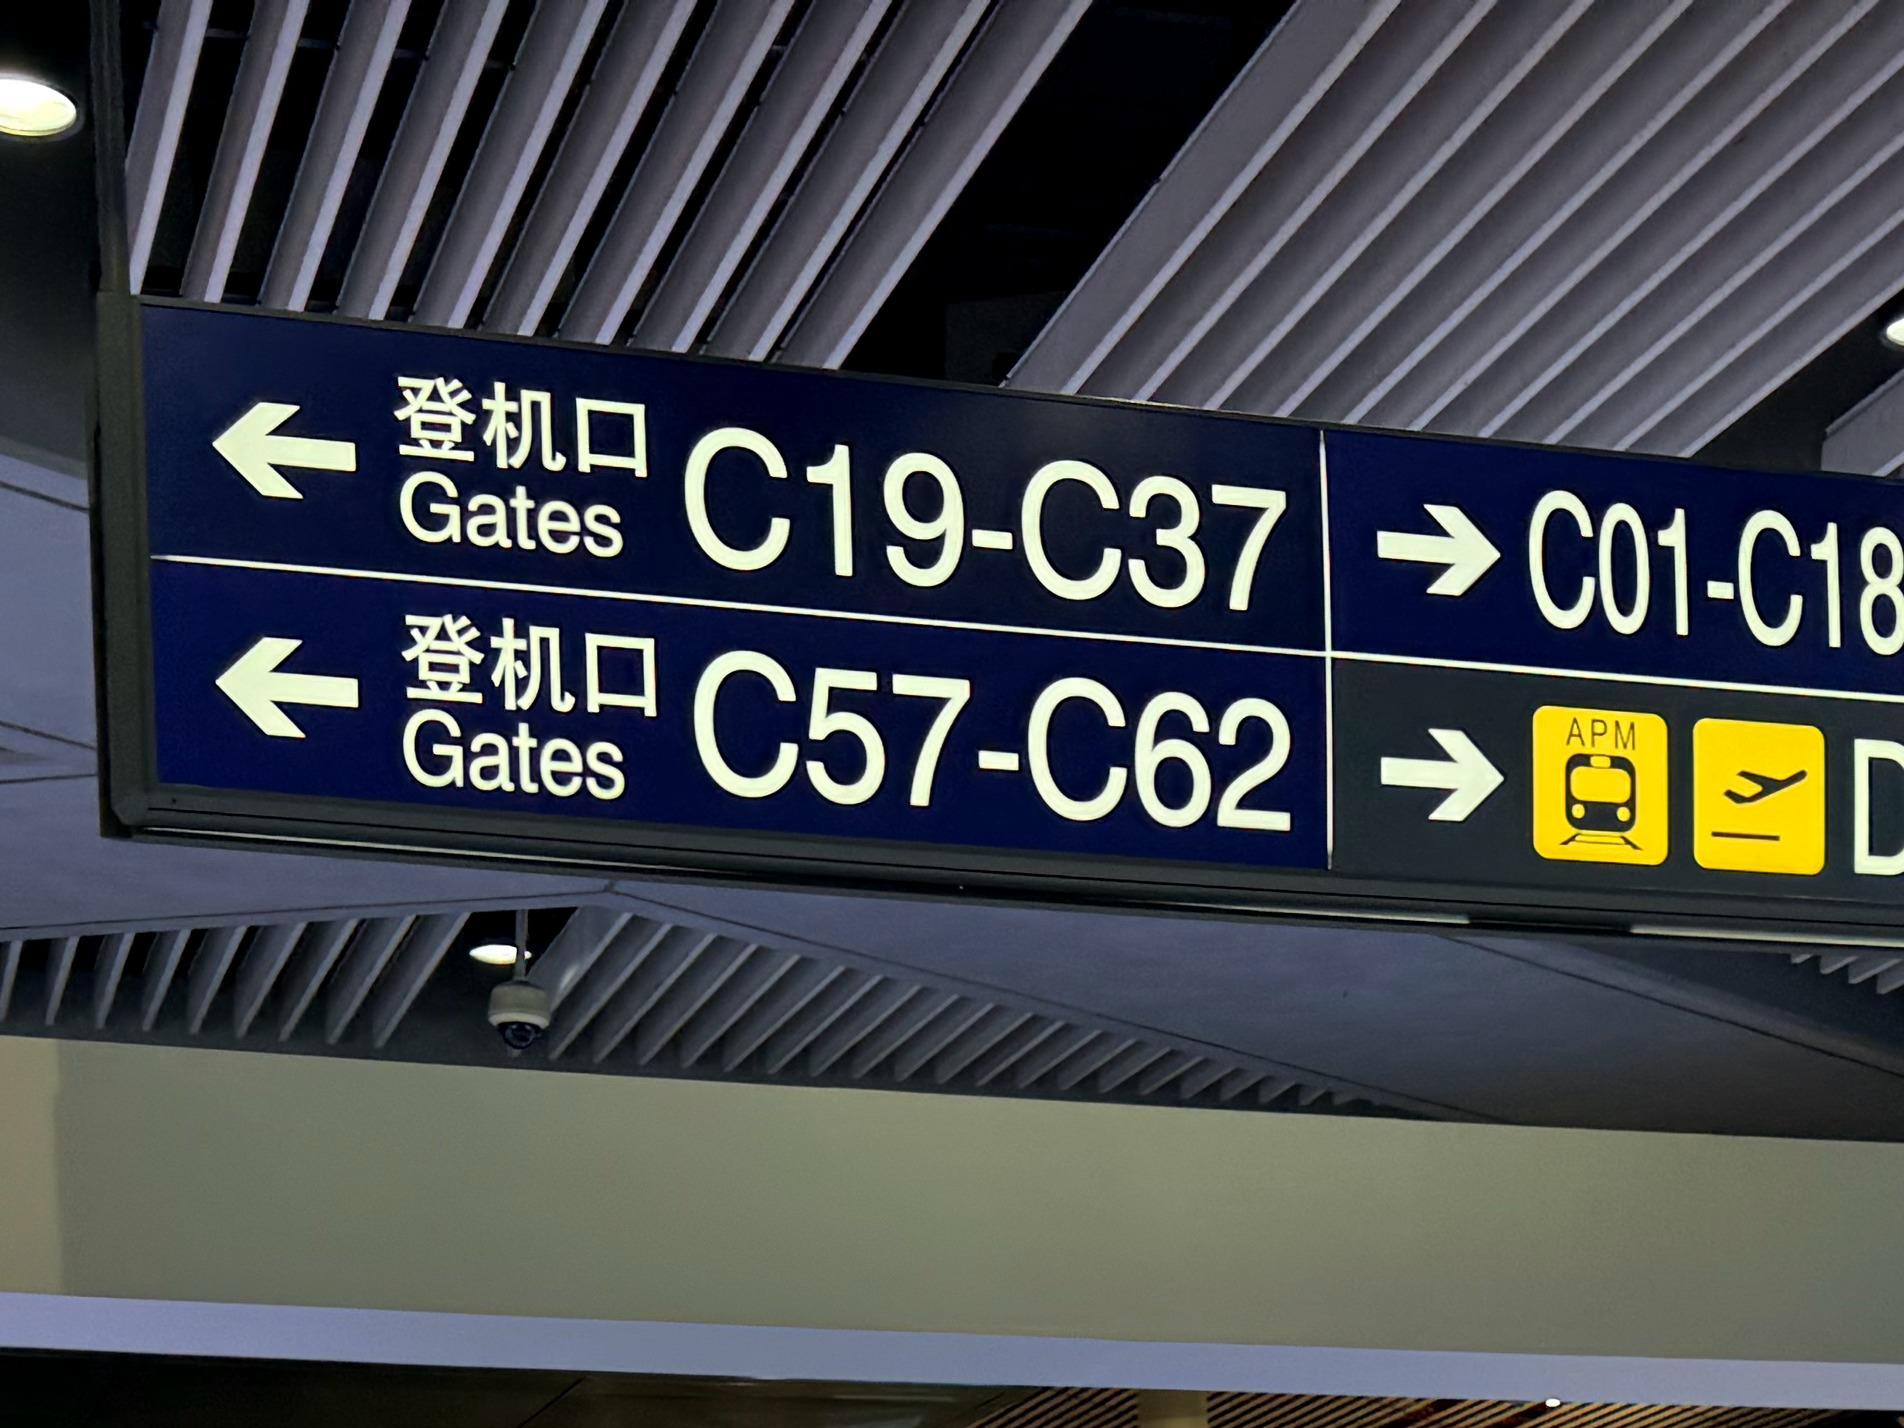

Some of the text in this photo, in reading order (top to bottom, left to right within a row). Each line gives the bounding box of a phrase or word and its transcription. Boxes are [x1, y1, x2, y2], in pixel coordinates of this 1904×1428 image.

[394, 377, 647, 477] 登机口
[400, 472, 623, 557] Gates
[685, 428, 1286, 610] C19-C37
[402, 614, 656, 716] 登机口
[403, 709, 624, 799] Gates
[694, 651, 1290, 831] C57-C62
[1566, 717, 1636, 750] APM
